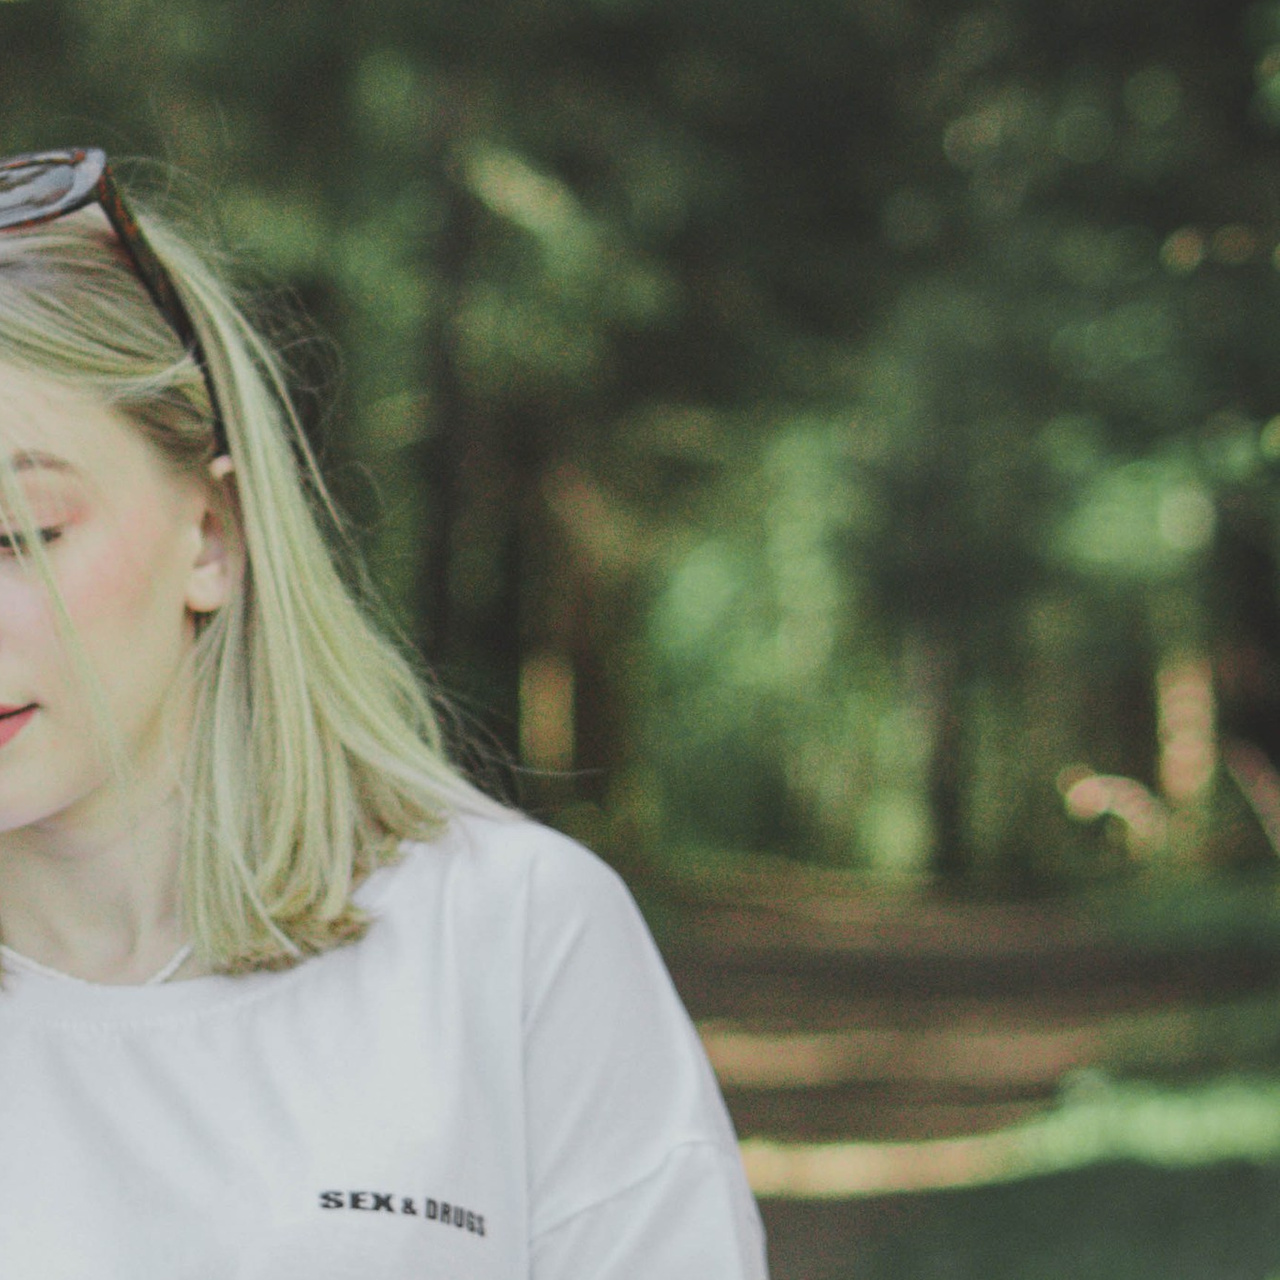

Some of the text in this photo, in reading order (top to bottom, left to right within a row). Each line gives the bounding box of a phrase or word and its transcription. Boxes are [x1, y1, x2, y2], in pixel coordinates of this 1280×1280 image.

[319, 1191, 486, 1237] SEX & DRUGS
